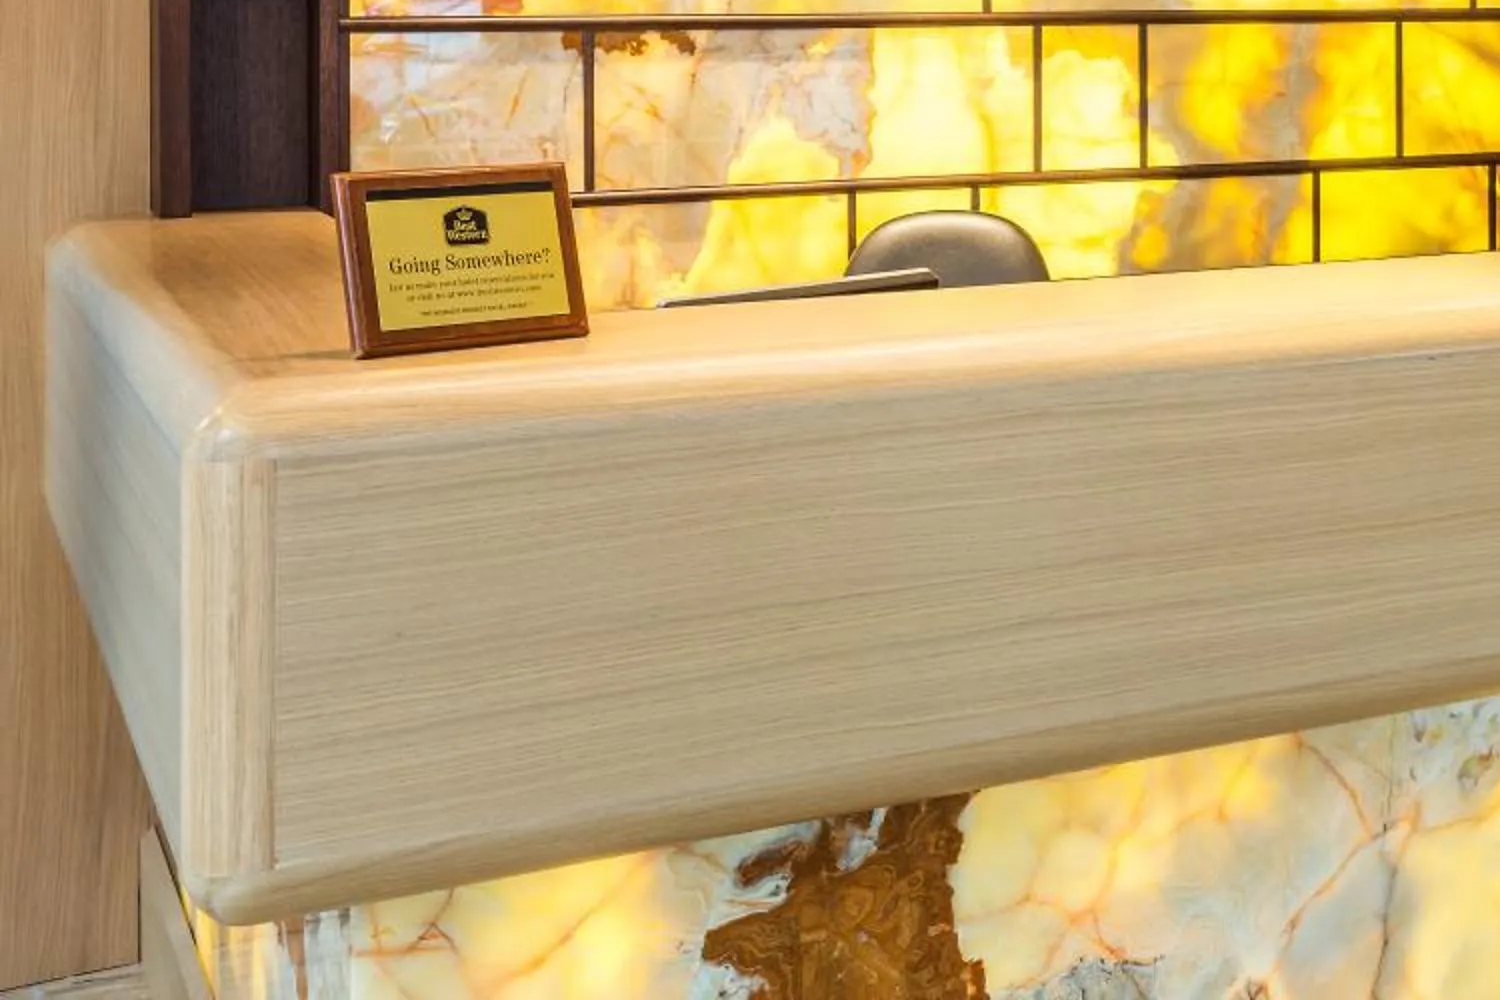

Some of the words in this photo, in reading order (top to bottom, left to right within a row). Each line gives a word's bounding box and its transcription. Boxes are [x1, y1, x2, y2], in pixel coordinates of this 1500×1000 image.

[453, 219, 477, 231] Best
[388, 257, 441, 277] Going
[445, 247, 551, 271] Somewhere?
